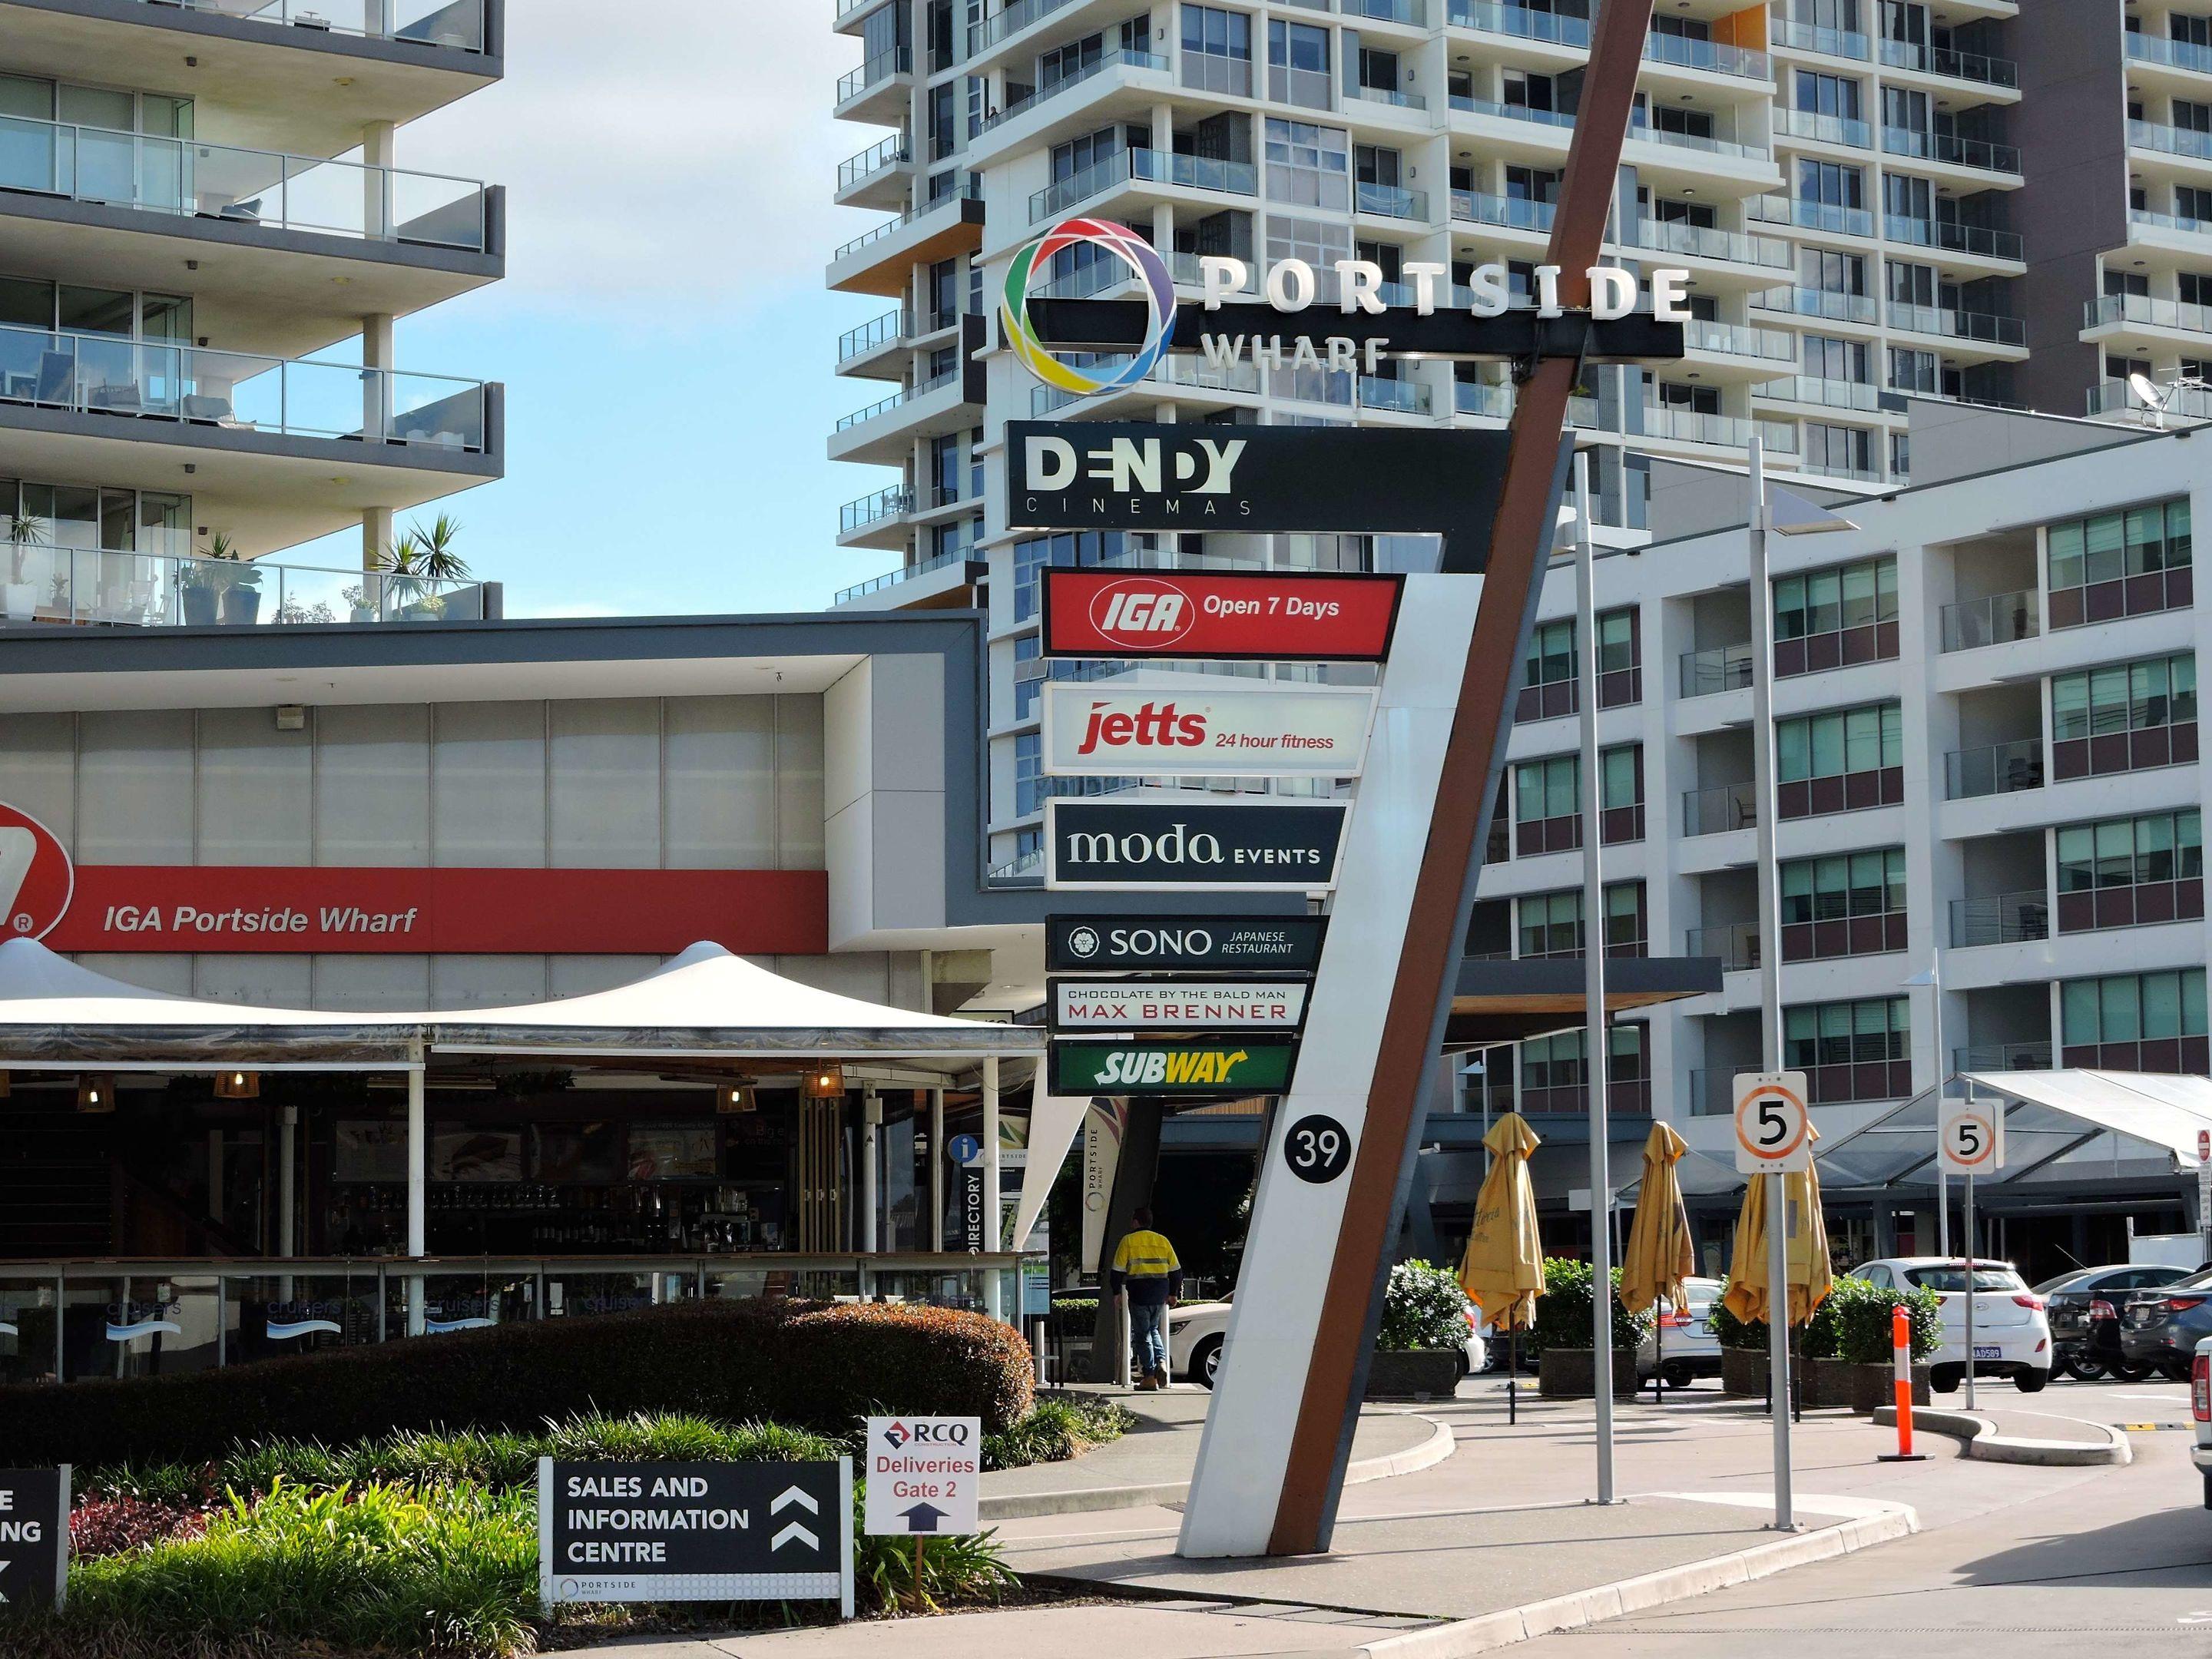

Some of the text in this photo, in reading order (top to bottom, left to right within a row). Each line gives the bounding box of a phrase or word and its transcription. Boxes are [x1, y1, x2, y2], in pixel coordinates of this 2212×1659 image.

[1199, 256, 1692, 322] PORTSIDE
[1200, 333, 1390, 373] WHARF
[1025, 435, 1249, 494] DENDY
[1027, 497, 1250, 516] CINEMAS
[1101, 593, 1184, 631] IGA
[1204, 594, 1339, 621] Open 7 Days
[1078, 701, 1207, 755] jetts
[1216, 733, 1335, 750] 24 hour fitness
[1067, 824, 1225, 864] moda
[1234, 849, 1320, 864] EVENTS
[103, 905, 417, 933] IGA Portside Wharf
[1110, 929, 1212, 955] SONO
[1221, 943, 1293, 954] RESTAURANT
[1229, 932, 1285, 942] JAPANESE
[1068, 990, 1286, 999] CHOCOLATE BY THE BALD MAN
[1068, 1004, 1286, 1019] MAX BRENNER
[1094, 1049, 1248, 1085] SUBWAY
[1759, 1101, 1787, 1145] 5
[1296, 1130, 1339, 1167] 39
[1959, 1124, 1979, 1156] 5
[1089, 1129, 1098, 1189] PORTSIDE
[914, 1423, 969, 1446] RCQ
[876, 1456, 975, 1473] Deliveries
[568, 1476, 708, 1498] SALES AND
[893, 1481, 956, 1498] Gate 2
[568, 1508, 750, 1530] INFORMATION
[568, 1541, 667, 1563] CENTRE
